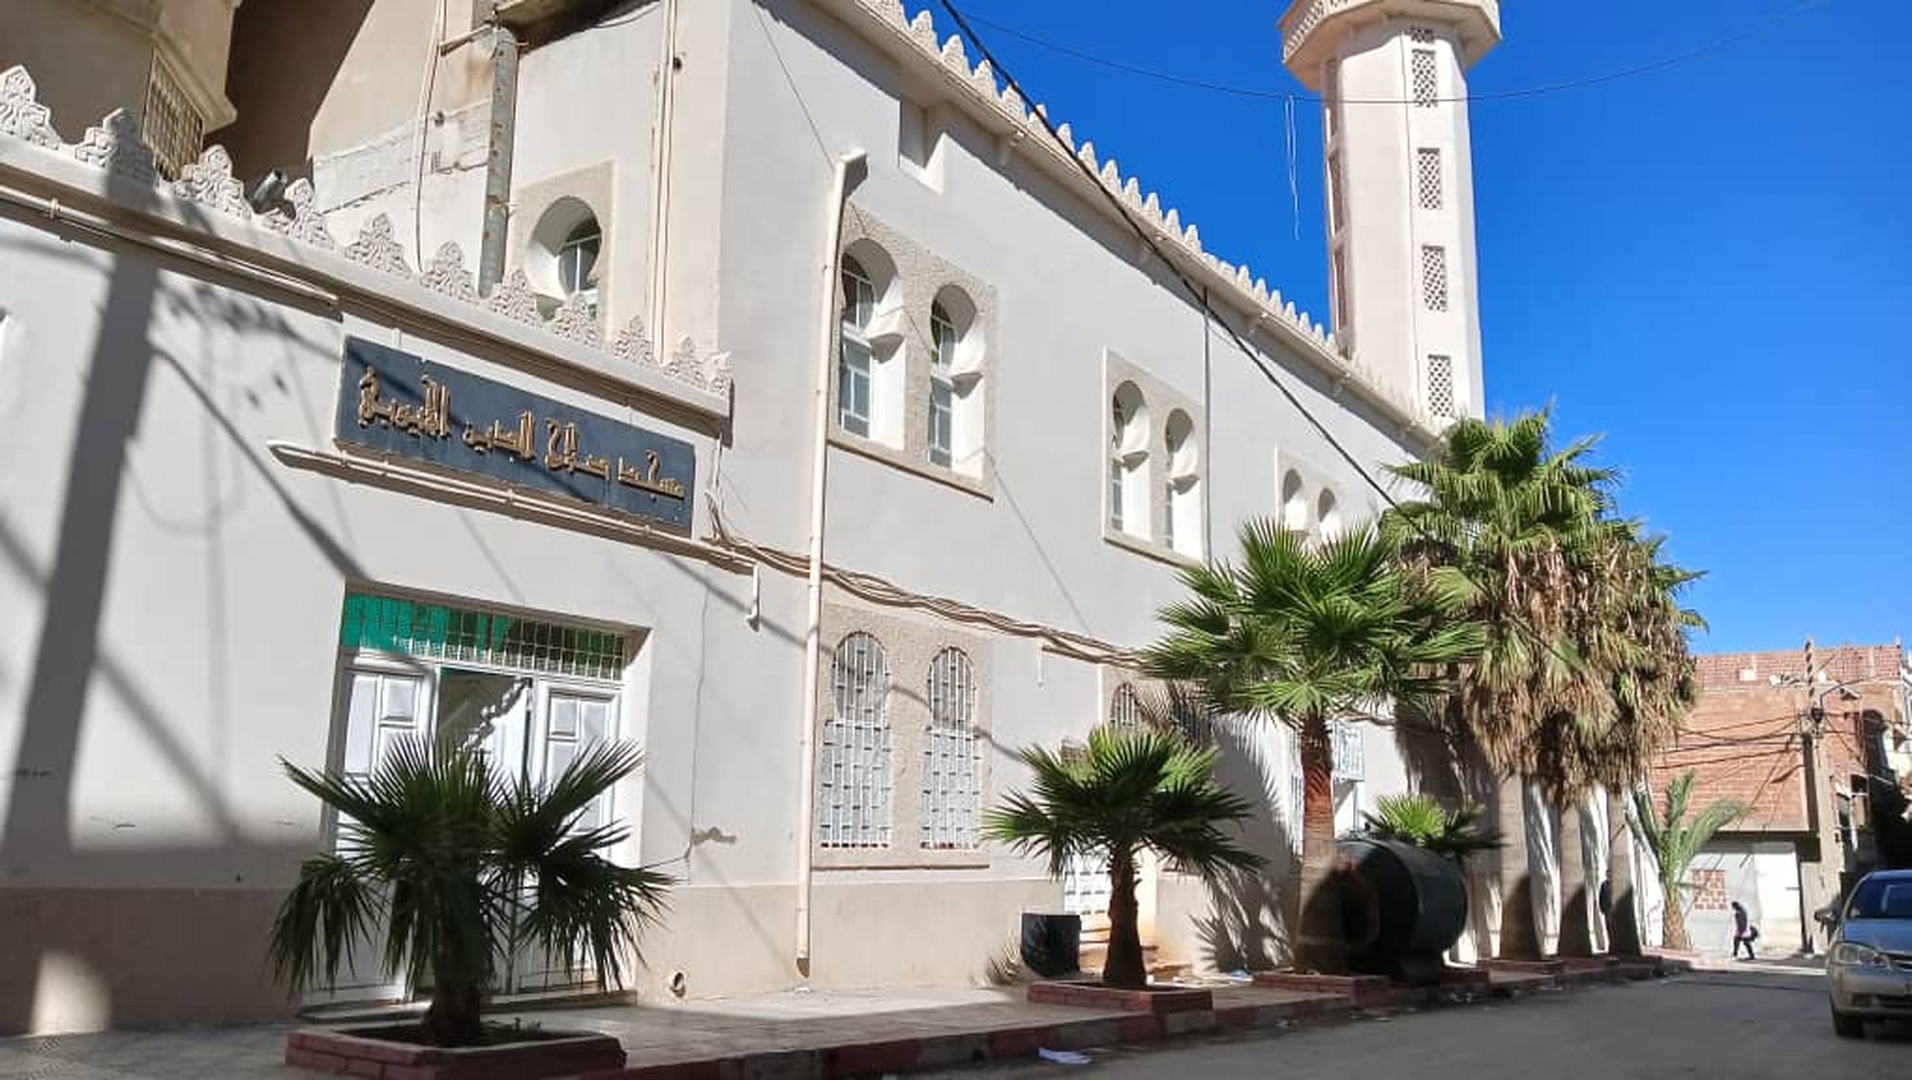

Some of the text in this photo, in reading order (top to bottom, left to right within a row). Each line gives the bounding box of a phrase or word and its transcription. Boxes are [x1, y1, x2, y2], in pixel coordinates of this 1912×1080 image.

[462, 410, 536, 461] الدين
[543, 417, 611, 482] صلاح
[617, 450, 685, 502] مسجد
